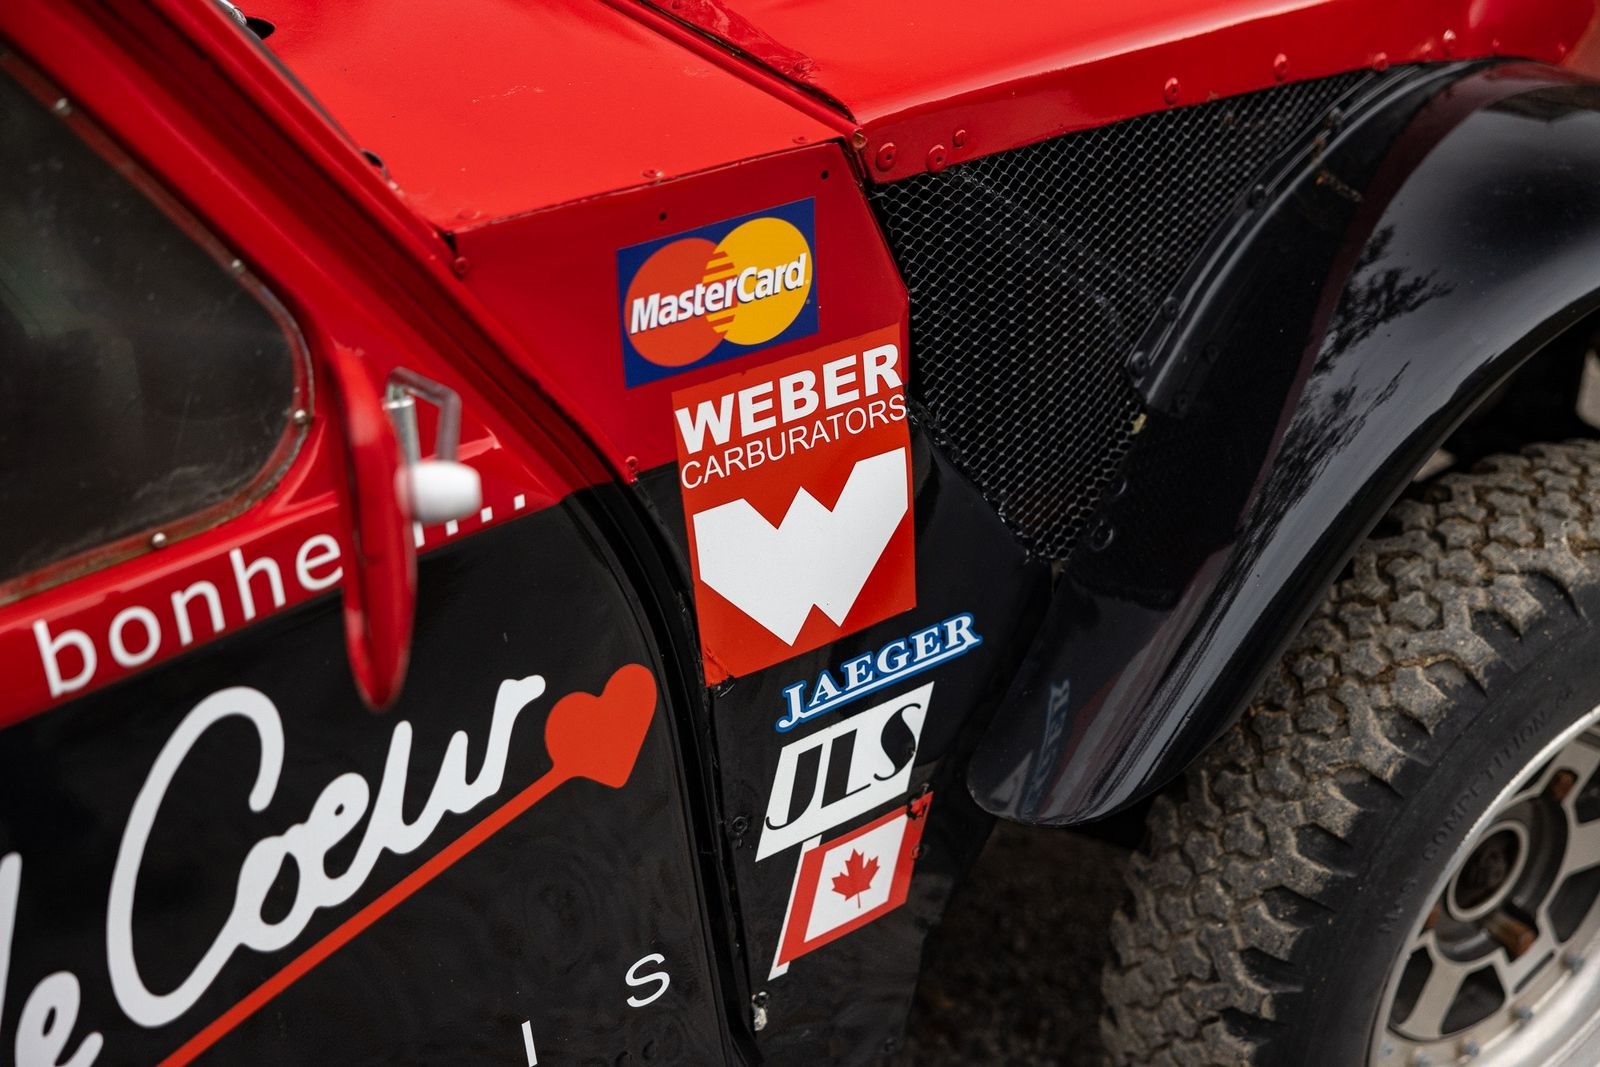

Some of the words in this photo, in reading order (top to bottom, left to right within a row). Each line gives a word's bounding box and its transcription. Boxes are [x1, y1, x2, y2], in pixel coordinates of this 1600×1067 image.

[630, 253, 807, 335] MasterCard
[675, 344, 903, 455] WEBER
[681, 394, 907, 489] CARBURATORS
[776, 613, 981, 731] JAEGER
